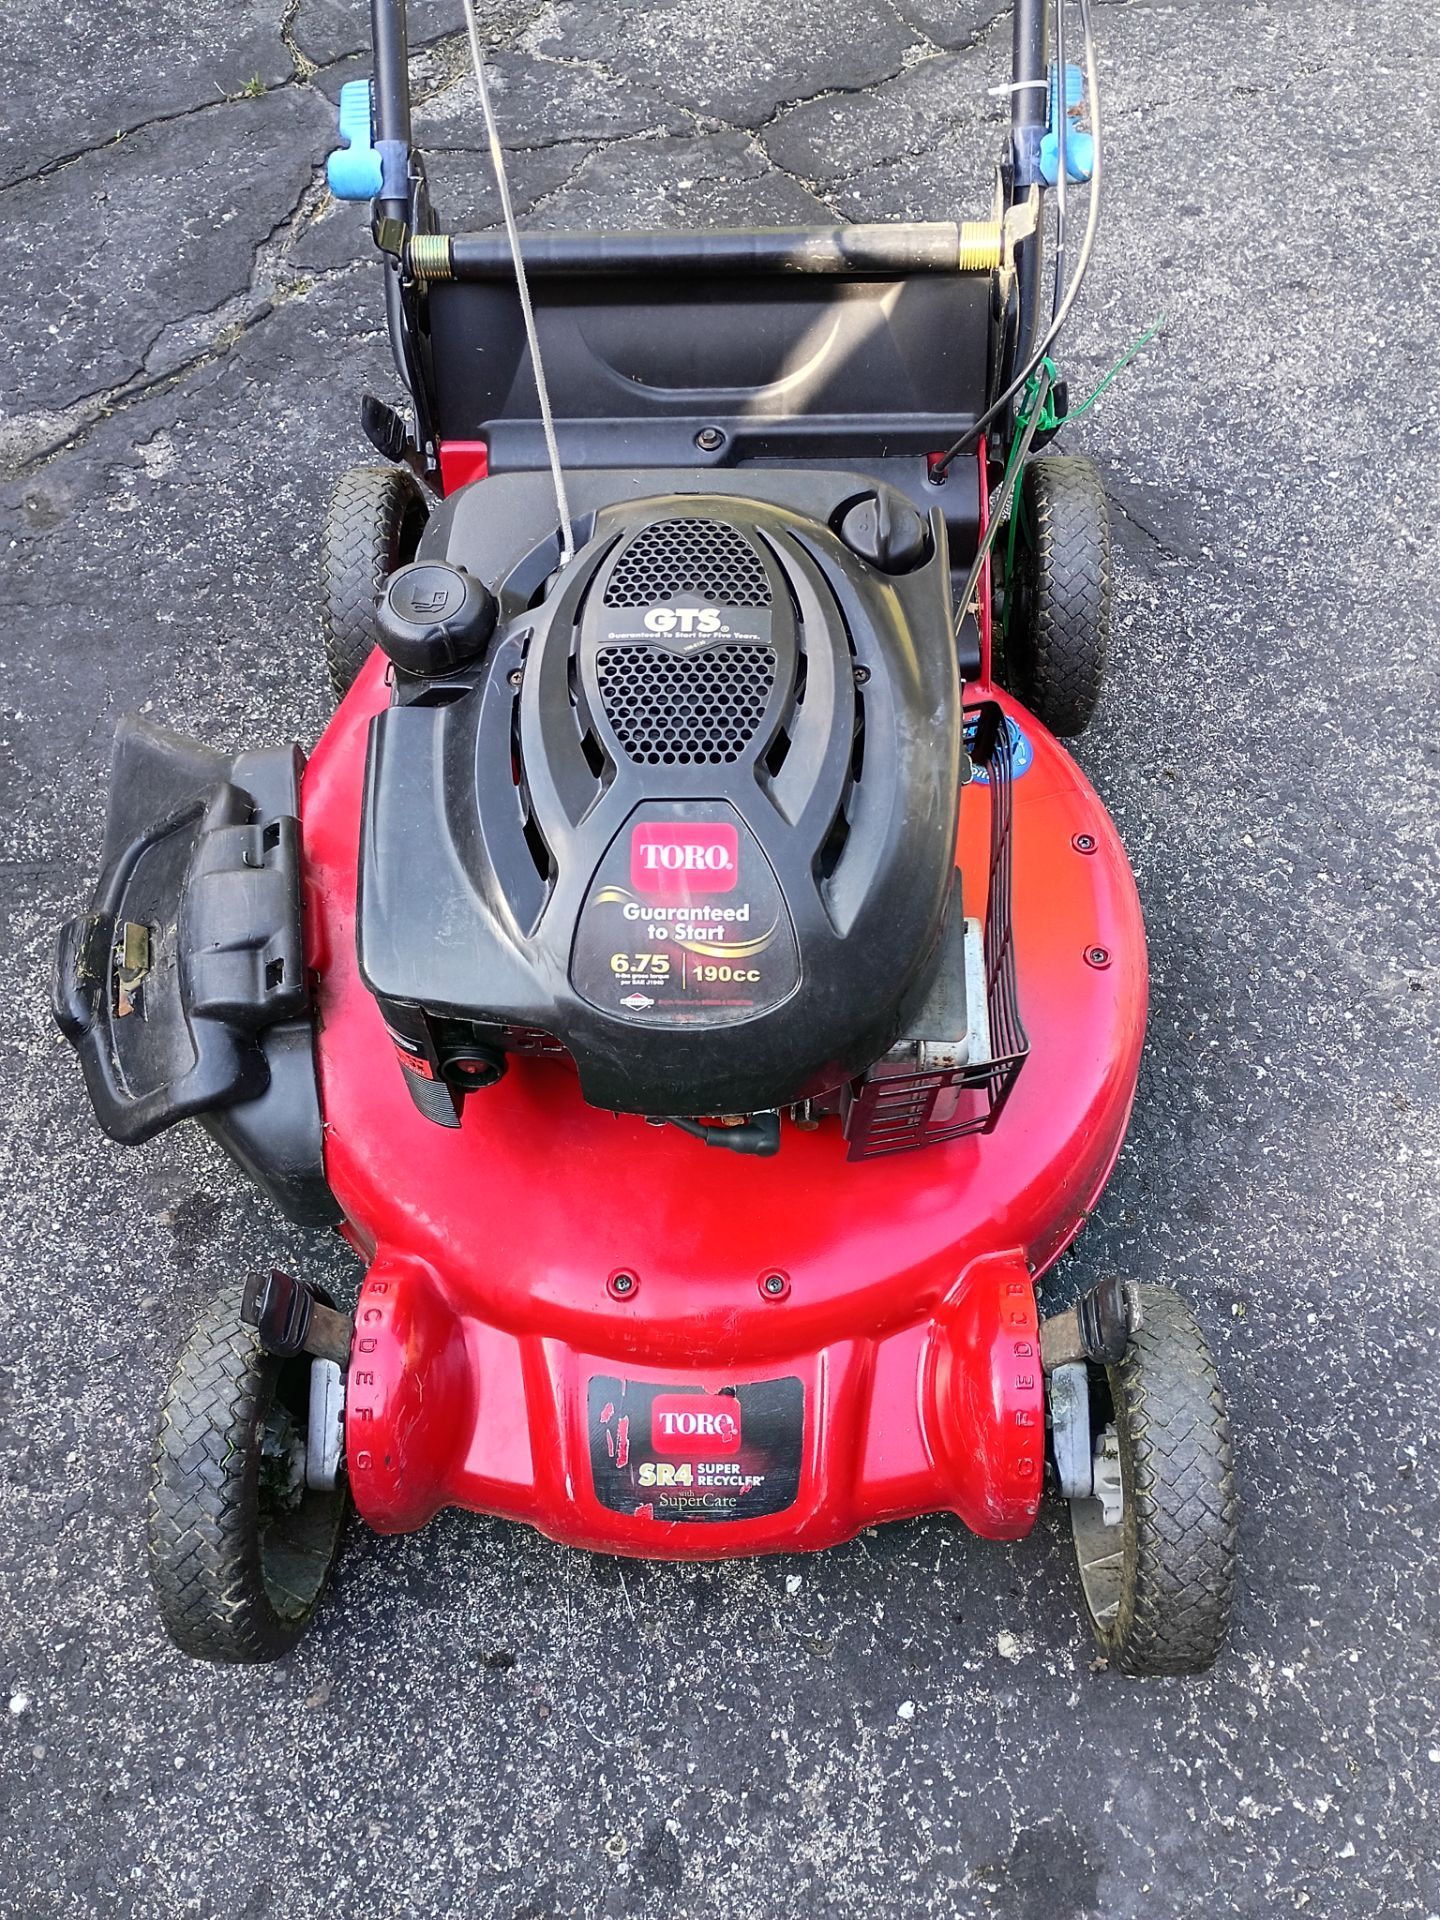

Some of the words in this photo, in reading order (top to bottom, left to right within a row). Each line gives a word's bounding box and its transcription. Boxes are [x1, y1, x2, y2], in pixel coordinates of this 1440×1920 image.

[644, 608, 721, 632] GTS
[608, 632, 661, 640] Guaranteed
[623, 903, 750, 922] Guaranteed
[647, 925, 668, 940] to
[674, 924, 725, 941] Start
[610, 953, 670, 973] 6.75
[692, 965, 761, 982] 190cc
[638, 1462, 694, 1487] SR4
[697, 1463, 741, 1474] SUPER
[659, 1492, 737, 1511] SuperCare
